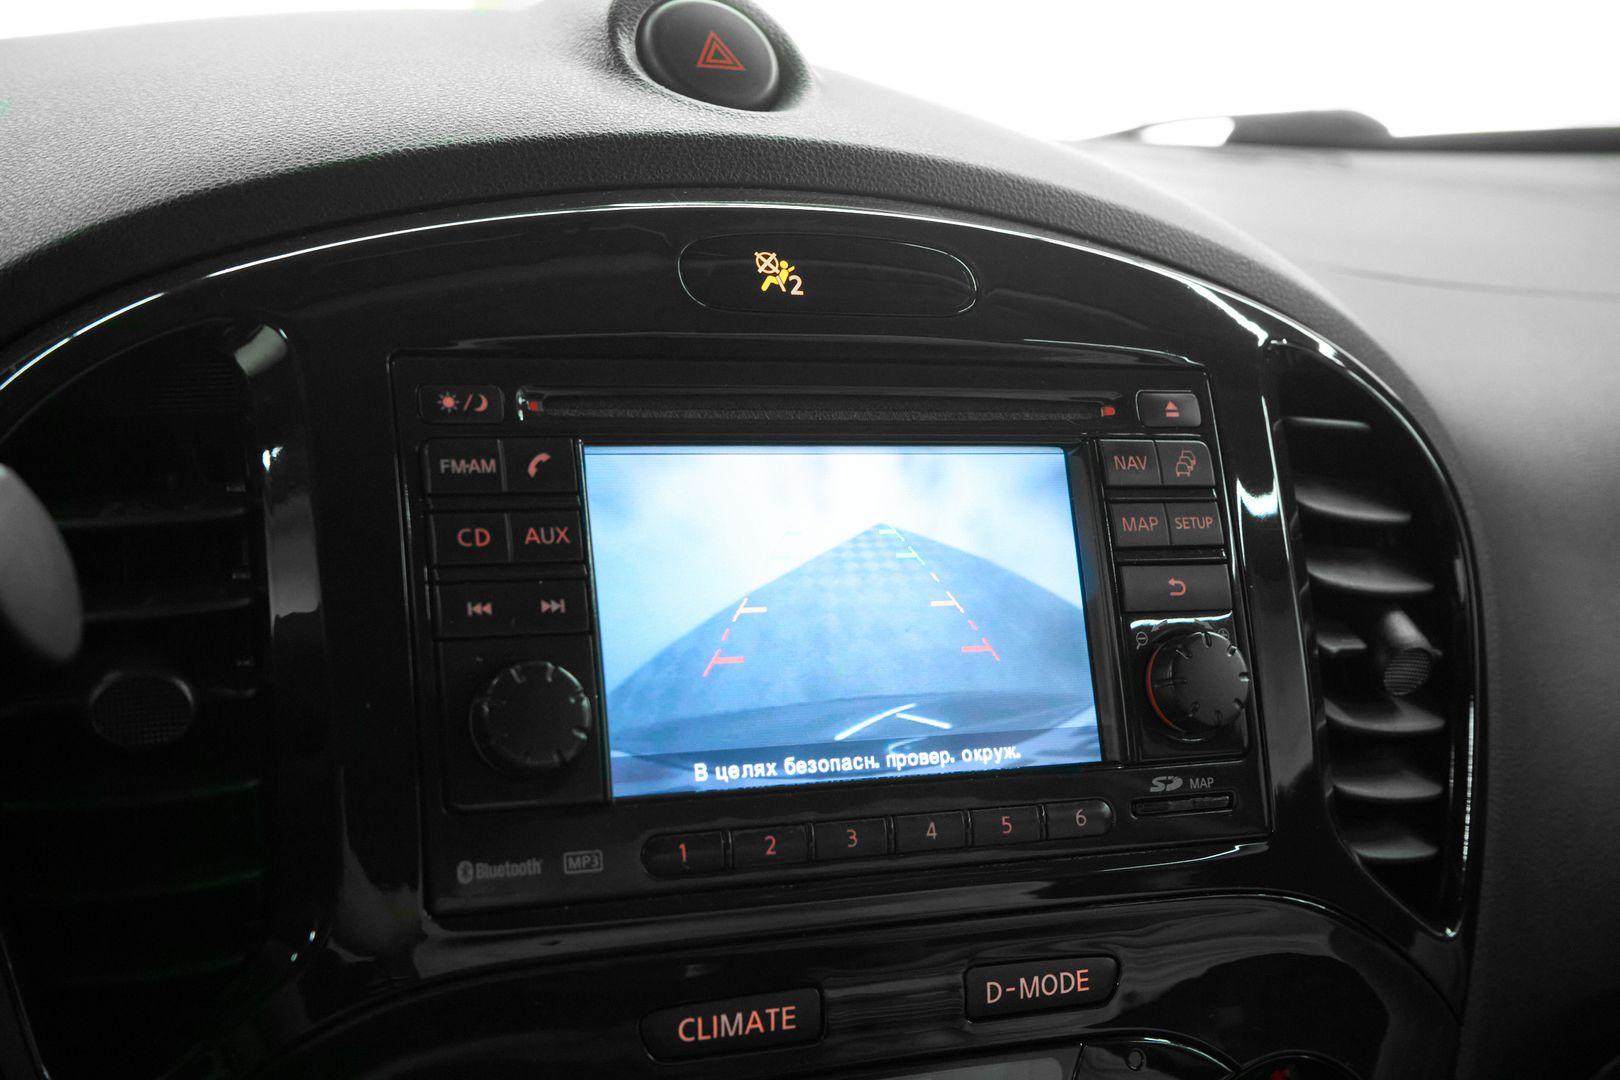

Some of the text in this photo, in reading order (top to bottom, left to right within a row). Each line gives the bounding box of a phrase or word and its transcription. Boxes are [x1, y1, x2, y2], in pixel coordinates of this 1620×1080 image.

[788, 274, 804, 296] 2
[1114, 455, 1147, 471] NAV
[1121, 516, 1159, 532] MAP
[1174, 515, 1214, 530] SETUP
[457, 528, 491, 547] CD
[524, 526, 570, 545] AUX
[693, 744, 1021, 783] В целях безопасн. провер. окруж.
[1151, 775, 1215, 793] SD MAP
[1002, 815, 1012, 835] 5
[1075, 808, 1087, 827] 6
[846, 828, 858, 849] 3
[926, 821, 938, 840] 4
[678, 843, 687, 863] 1
[764, 835, 777, 856] 2
[475, 857, 542, 880] Bluetooth
[567, 854, 599, 870] MP3
[985, 968, 1091, 1005] D-MODE
[677, 1005, 797, 1042] CLIMATE
